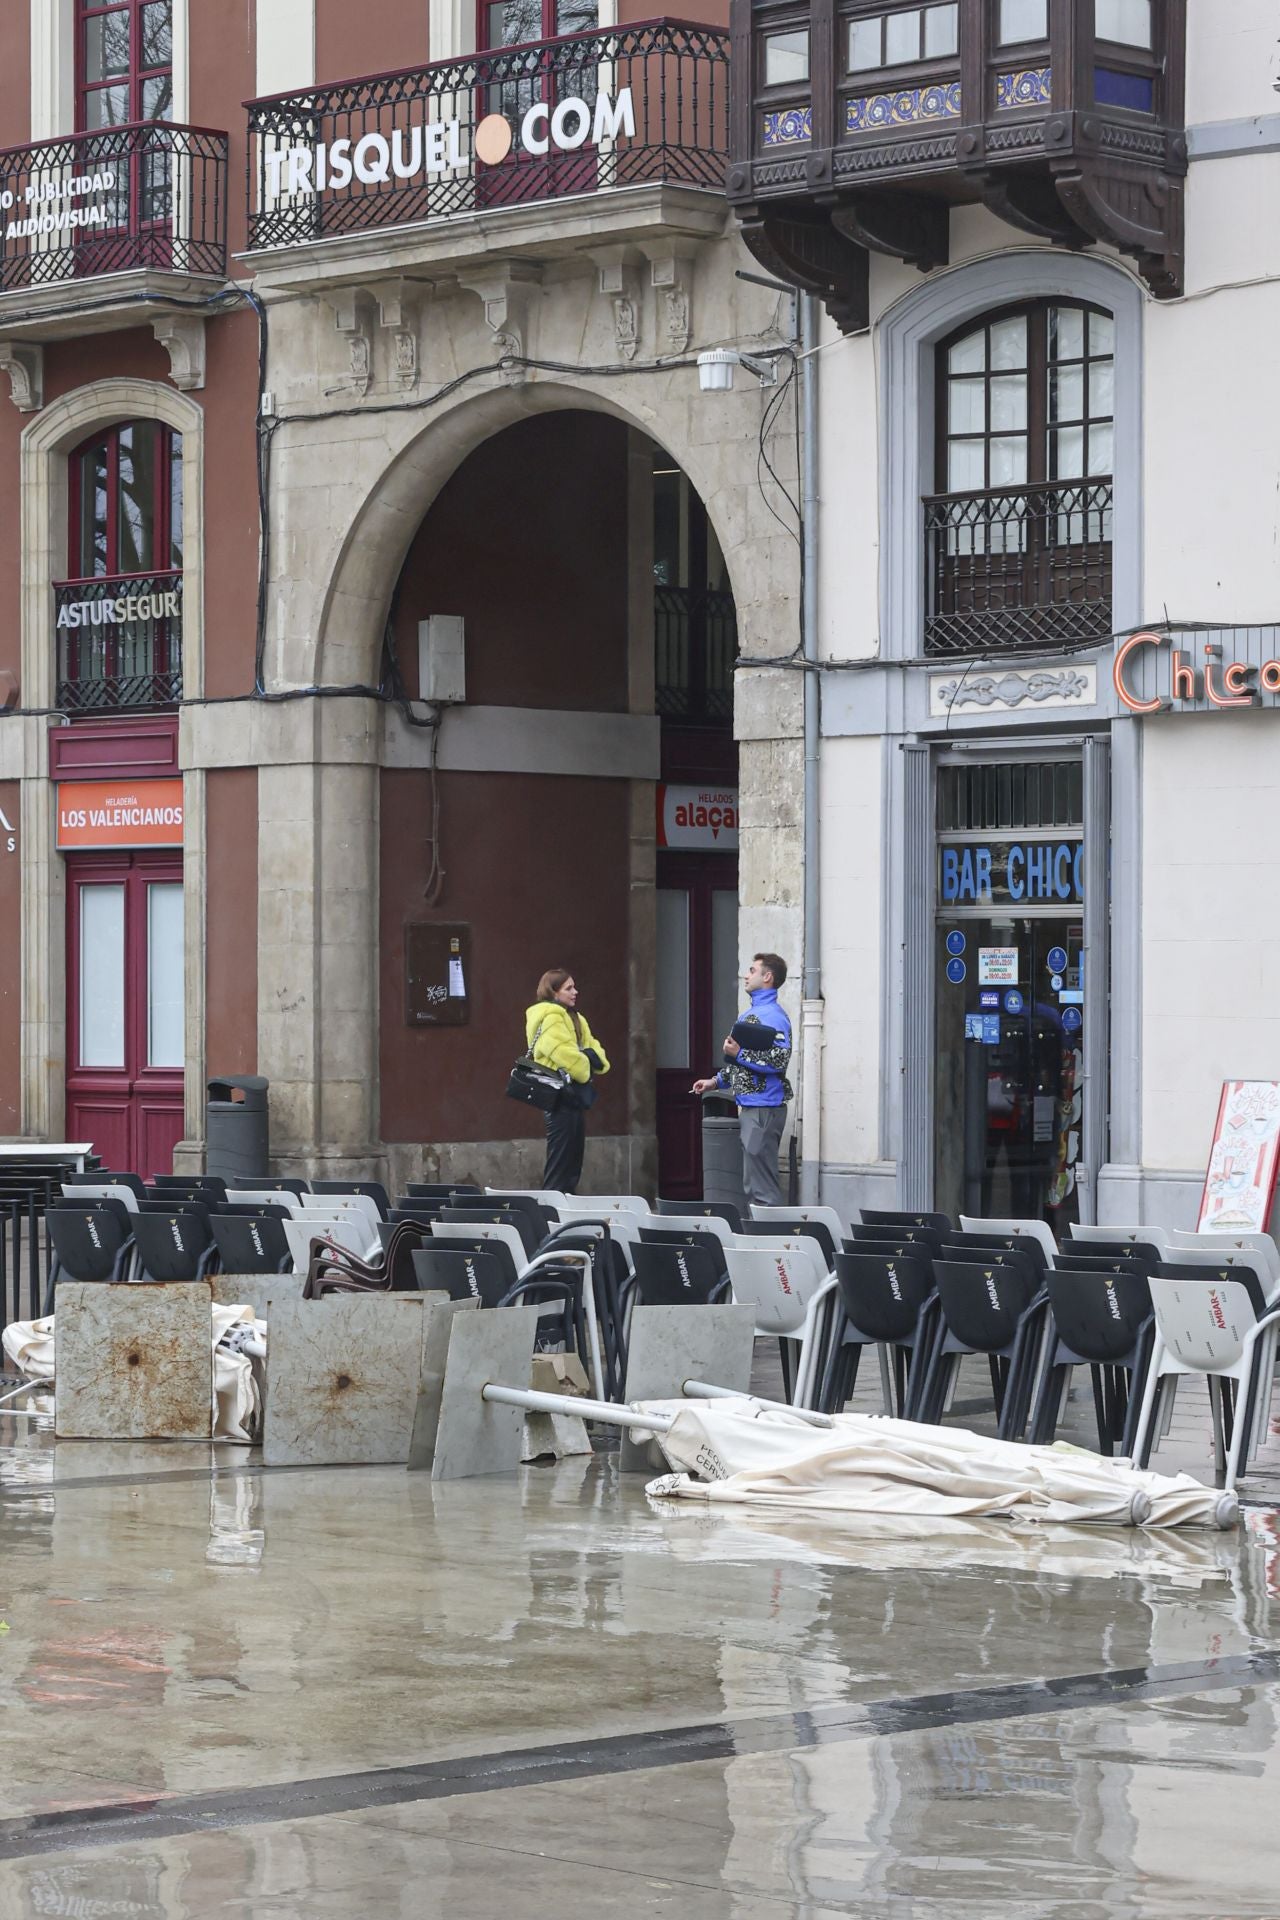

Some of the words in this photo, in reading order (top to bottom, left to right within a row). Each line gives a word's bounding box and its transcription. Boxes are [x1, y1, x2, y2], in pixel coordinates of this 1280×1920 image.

[265, 119, 469, 199] TRISQUEL
[521, 87, 636, 156] COM
[25, 171, 115, 205] PUBLICIDAD
[5, 204, 108, 240] AUDIOVISUAL
[1113, 631, 1280, 713] Chico
[105, 795, 138, 806] HELADERÍA
[698, 793, 734, 804] HELADOS
[61, 810, 86, 828] LOS
[89, 807, 183, 827] VALENCIANOS
[675, 801, 739, 840] alaça
[943, 847, 993, 900] BAR
[87, 1221, 102, 1249] AMBAR
[171, 1224, 185, 1252] AMBAR
[250, 1228, 265, 1256] AMBAR
[466, 1265, 480, 1297] AMBAR
[677, 1257, 692, 1288] AMBAR
[777, 1264, 792, 1295] AMBAR
[888, 1269, 903, 1301] AMBAR
[986, 1279, 1001, 1311] AMBAR
[1106, 1287, 1122, 1320] AMBAR
[1210, 1296, 1227, 1330] AMBAR
